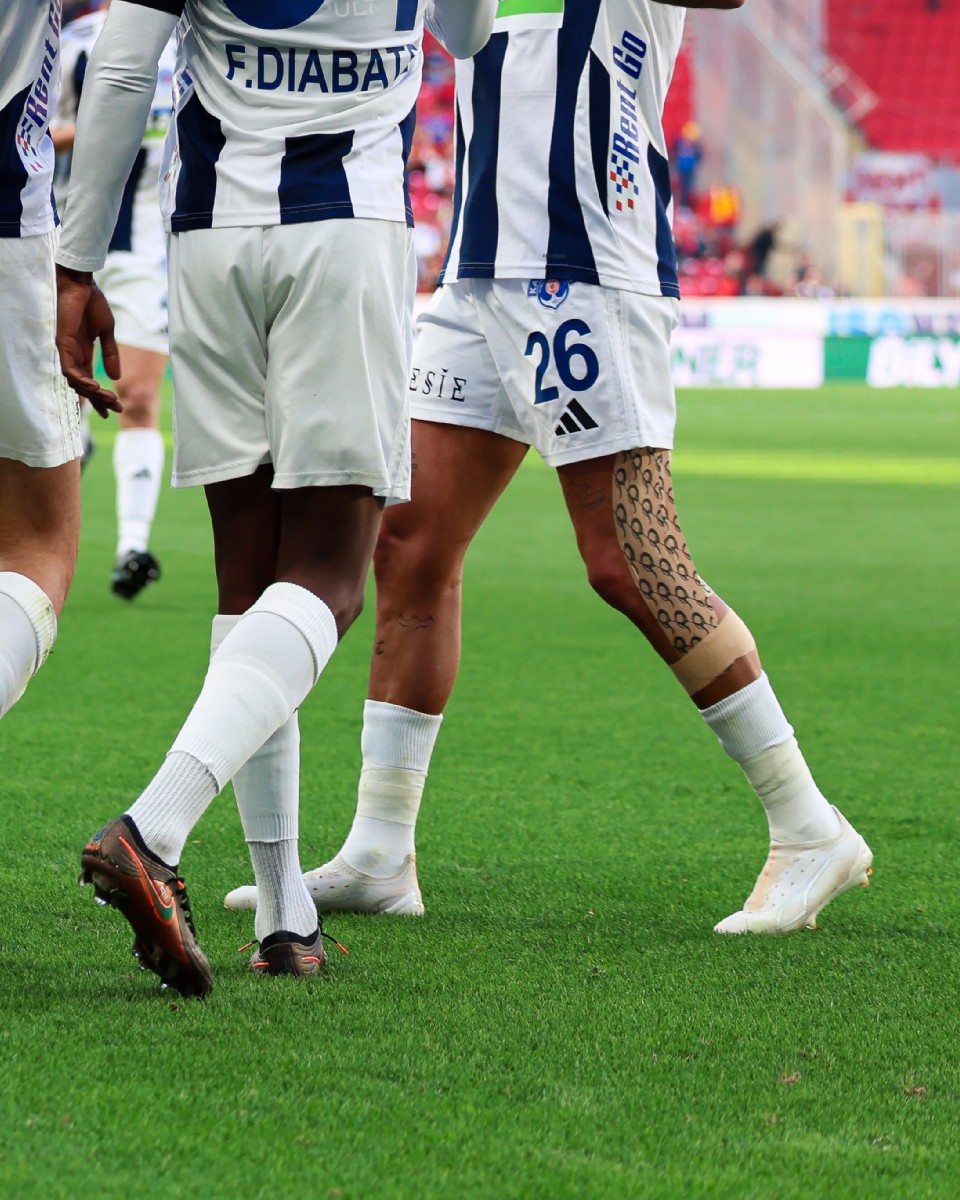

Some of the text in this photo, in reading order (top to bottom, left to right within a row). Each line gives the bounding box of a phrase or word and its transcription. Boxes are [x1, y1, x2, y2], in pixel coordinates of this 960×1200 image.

[27, 37, 58, 128] Rent
[612, 30, 647, 165] Rent Go
[524, 318, 600, 406] 26
